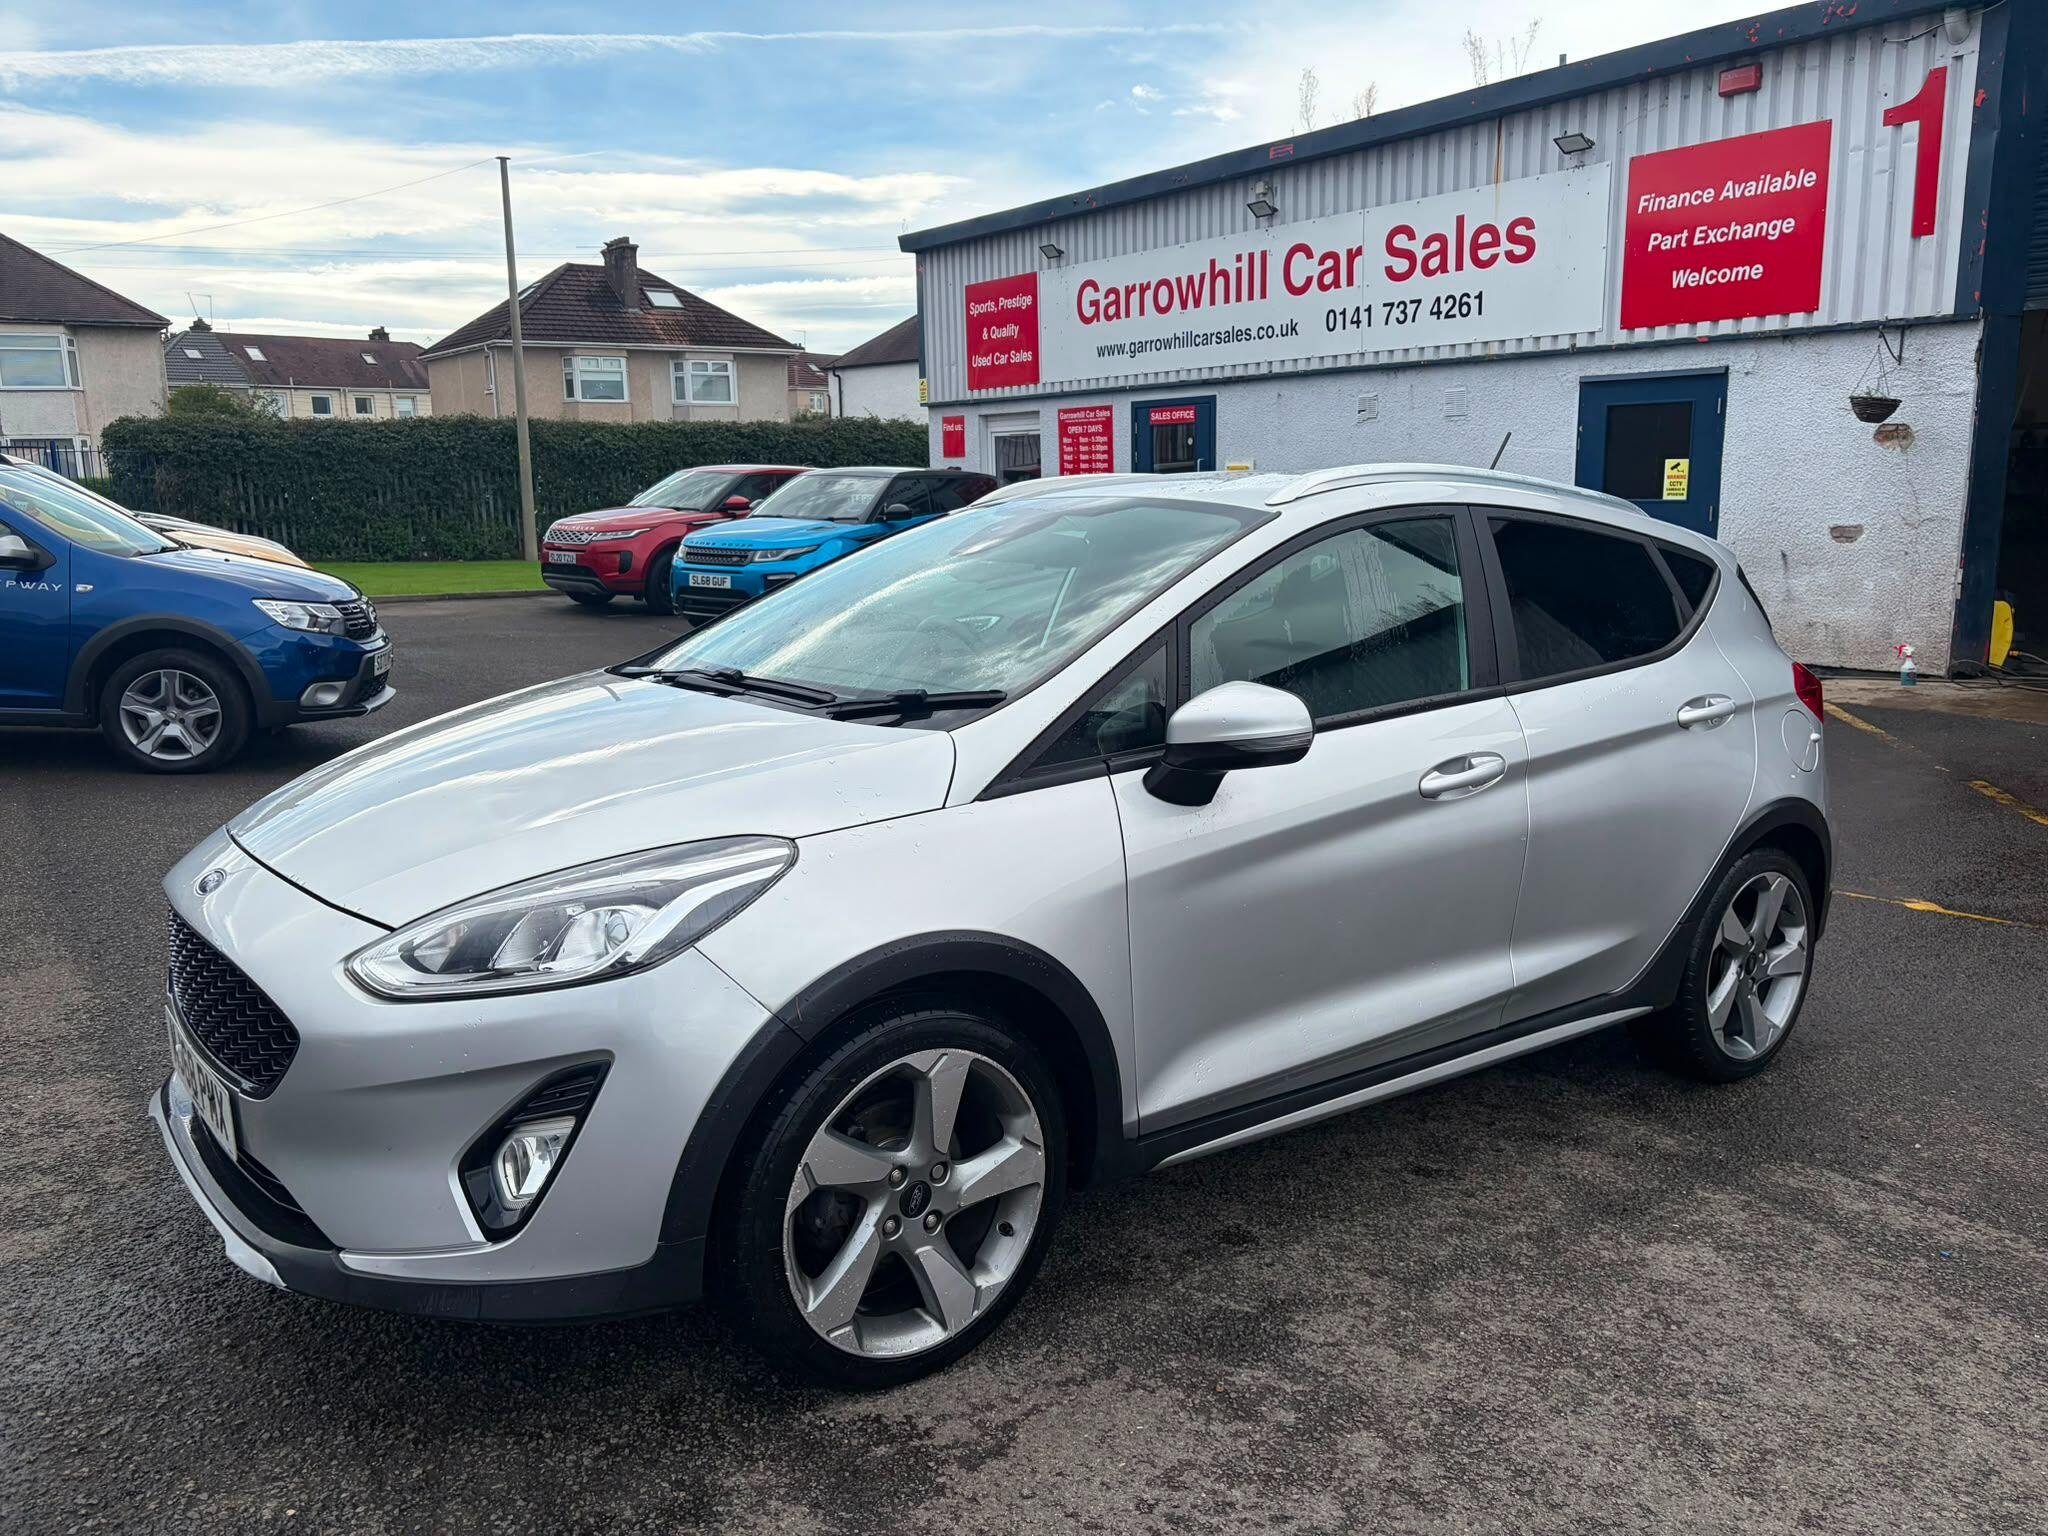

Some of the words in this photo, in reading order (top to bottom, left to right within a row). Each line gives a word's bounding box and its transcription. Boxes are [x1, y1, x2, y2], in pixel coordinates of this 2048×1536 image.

[1882, 66, 1947, 238] 1
[1637, 187, 1715, 215] Finance
[1719, 168, 1817, 201] Available
[1647, 229, 1689, 252] Part
[1693, 217, 1796, 246] Exchange
[1076, 249, 1268, 326] Garrowhill
[1282, 242, 1363, 297] Car
[1384, 213, 1537, 283] Sales
[1671, 263, 1764, 289] Welcome
[969, 300, 998, 318] Sports,
[998, 293, 1033, 311] Prestige
[1325, 304, 1373, 333] 0141
[1382, 298, 1423, 327] 737
[1429, 290, 1484, 321] 4261
[982, 327, 988, 341] &
[990, 323, 1020, 340] Quality
[1096, 318, 1299, 359] www.garrowhillcarsales.co.uk
[972, 353, 993, 368] Used
[993, 352, 1009, 366] Car
[1009, 349, 1033, 364] Sales
[1085, 410, 1095, 418] Car
[1150, 411, 1171, 421] SALES
[1171, 409, 1195, 420] OFFICE
[943, 423, 954, 432] Find
[1067, 426, 1082, 434] OPEN
[1087, 424, 1103, 433] DAYS
[0, 580, 63, 592] PWAY
[691, 575, 711, 586] SL68
[711, 576, 729, 588] GUF
